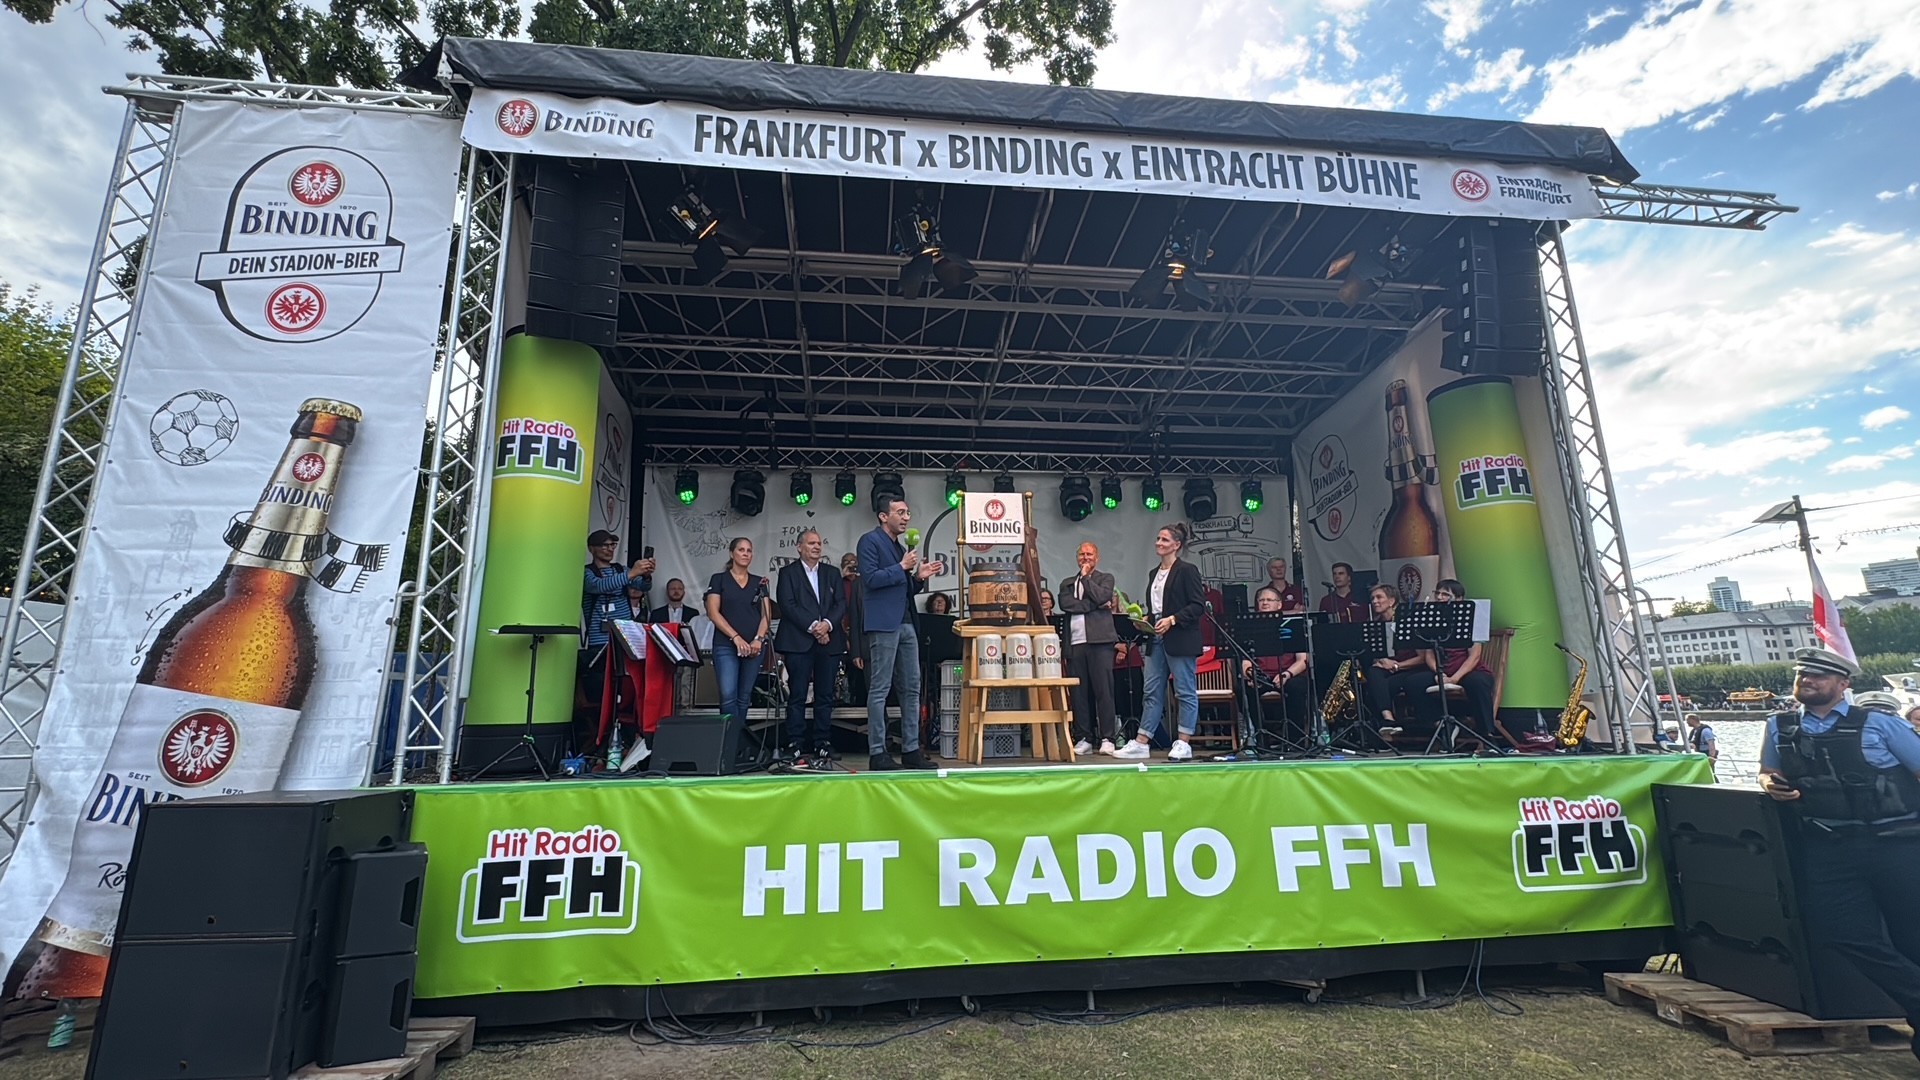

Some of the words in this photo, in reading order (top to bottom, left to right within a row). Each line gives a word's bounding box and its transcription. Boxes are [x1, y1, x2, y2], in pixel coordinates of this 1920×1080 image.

[544, 109, 655, 139] BINDING
[694, 113, 906, 167] FRANKFURT
[948, 133, 1094, 178] BINDING
[1131, 144, 1304, 191] EINTRACHT
[1315, 151, 1421, 200] BÜHNE
[1496, 175, 1563, 194] EINTRACHT
[1499, 186, 1573, 204] FRANKFURT
[239, 203, 379, 241] BINDING
[228, 256, 266, 275] DEIN
[269, 251, 380, 273] STADION-BIER
[502, 420, 520, 435] Hit
[524, 419, 574, 439] Radio
[497, 434, 578, 472] FFH
[1461, 460, 1480, 473] Hit
[1484, 455, 1524, 469] Radio
[1313, 460, 1347, 495] BINDING
[1460, 467, 1532, 500] FFH
[970, 520, 1021, 535] BINDING
[128, 772, 151, 782] SEIT
[221, 787, 244, 795] 1870
[1521, 800, 1551, 822] Hit
[1553, 798, 1619, 821] Radio
[491, 833, 528, 858] Hit
[535, 829, 617, 856] Radio
[1523, 820, 1636, 873] FFH
[742, 840, 900, 917] HIT
[938, 827, 1237, 907] RADIO
[1270, 823, 1436, 893] FFH
[477, 856, 623, 921] FFH
